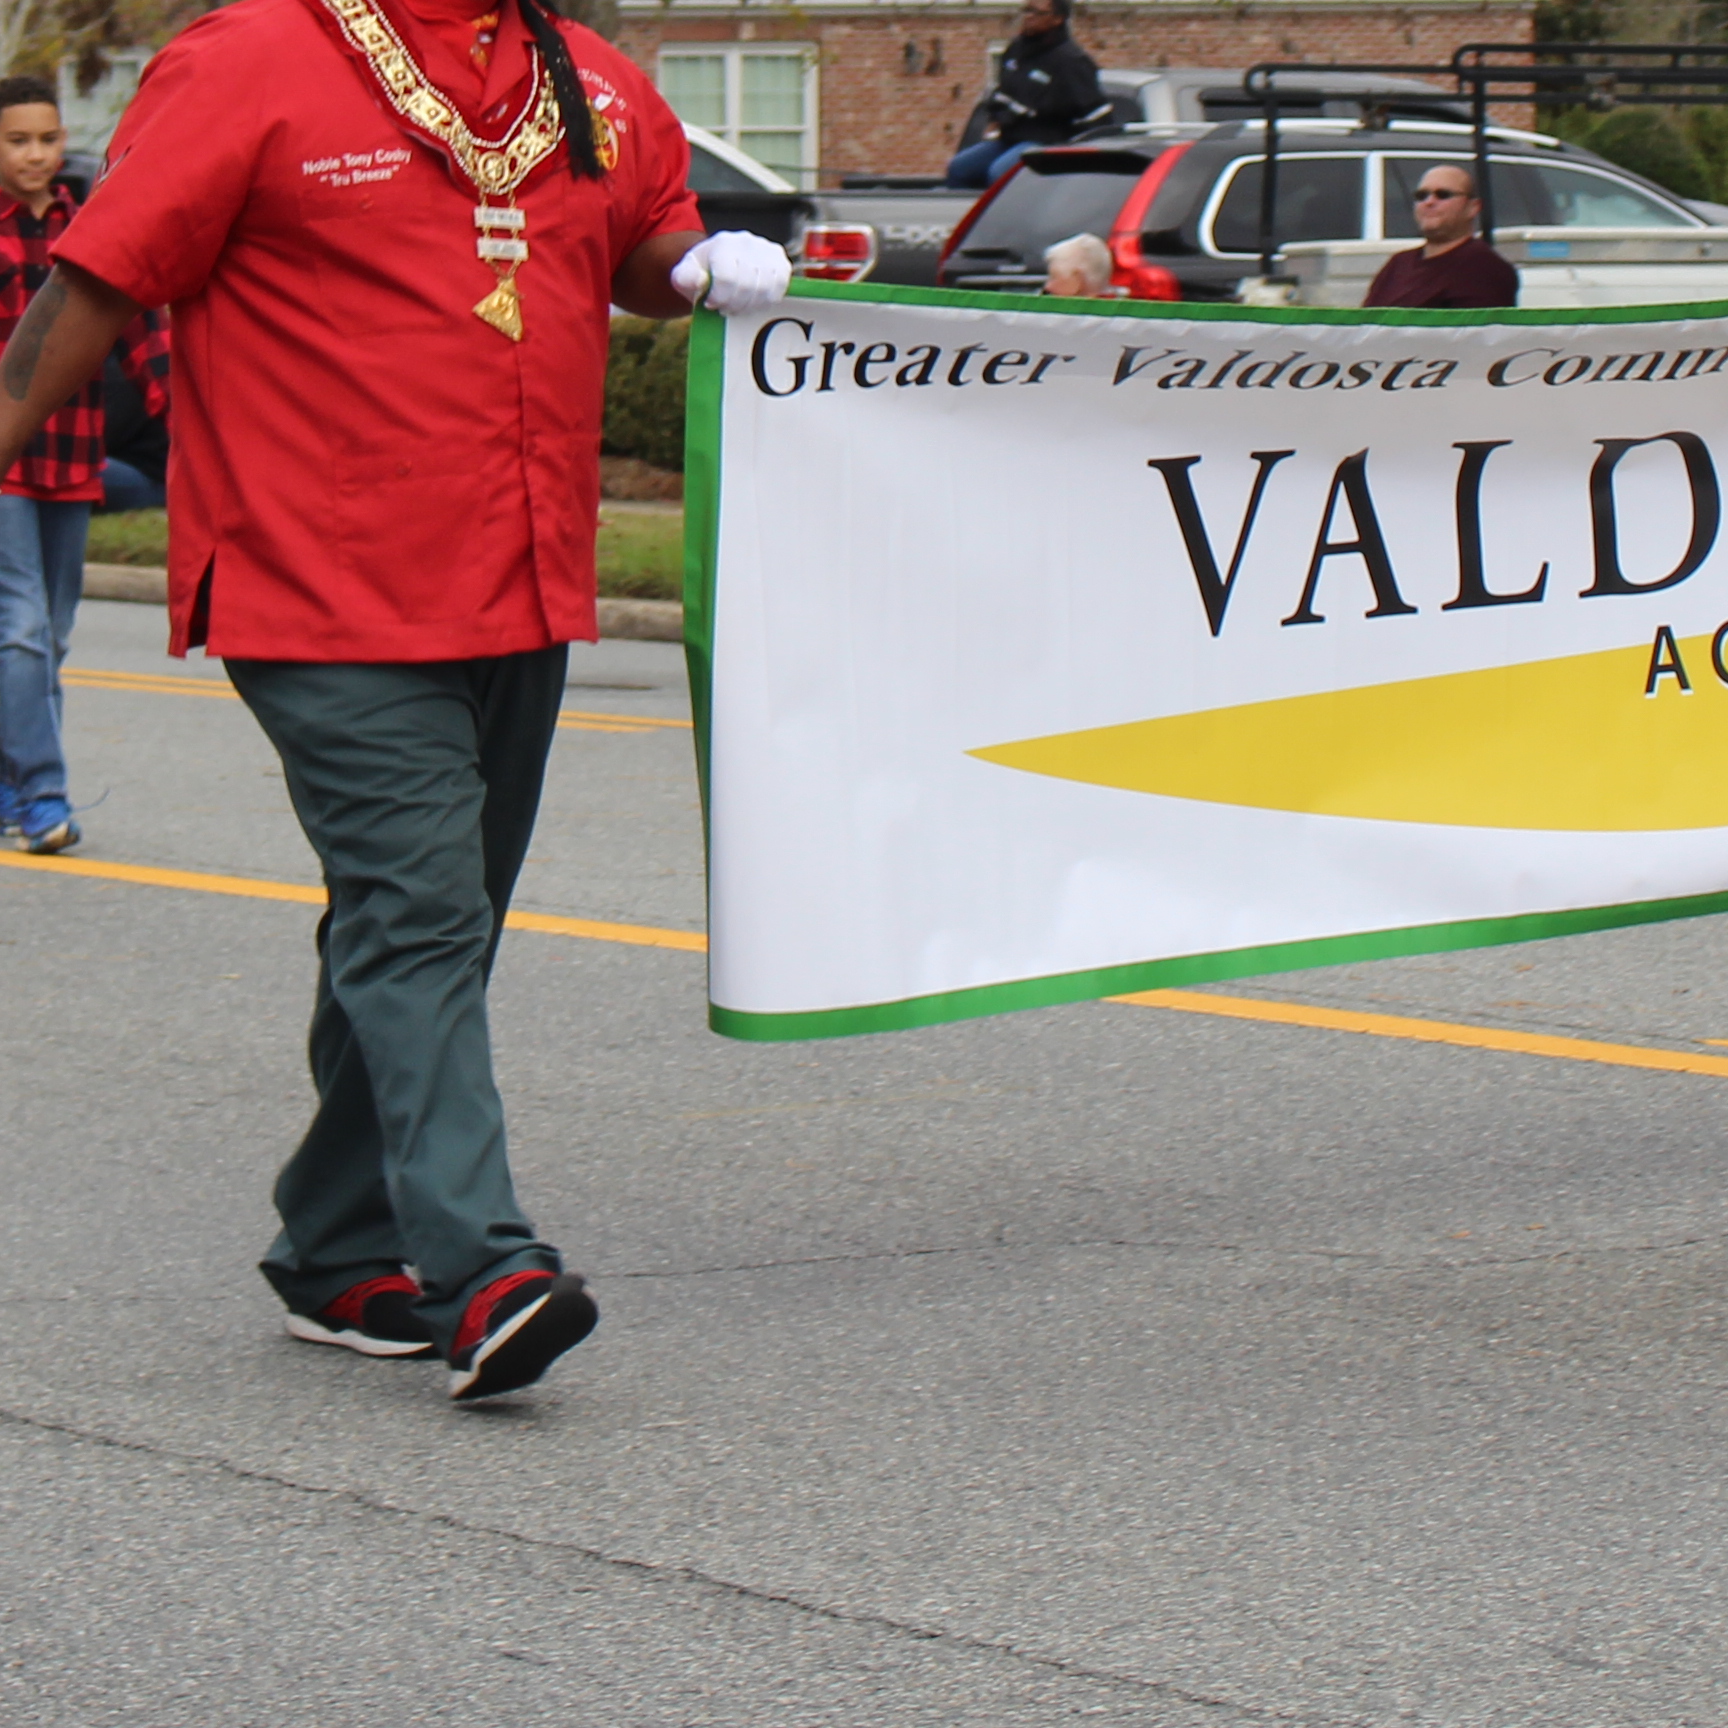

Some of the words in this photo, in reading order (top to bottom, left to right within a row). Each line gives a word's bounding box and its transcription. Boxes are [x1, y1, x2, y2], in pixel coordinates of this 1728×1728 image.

[751, 317, 1075, 397] Greater
[1112, 345, 1460, 392] Valdosta
[1645, 625, 1692, 694] A
